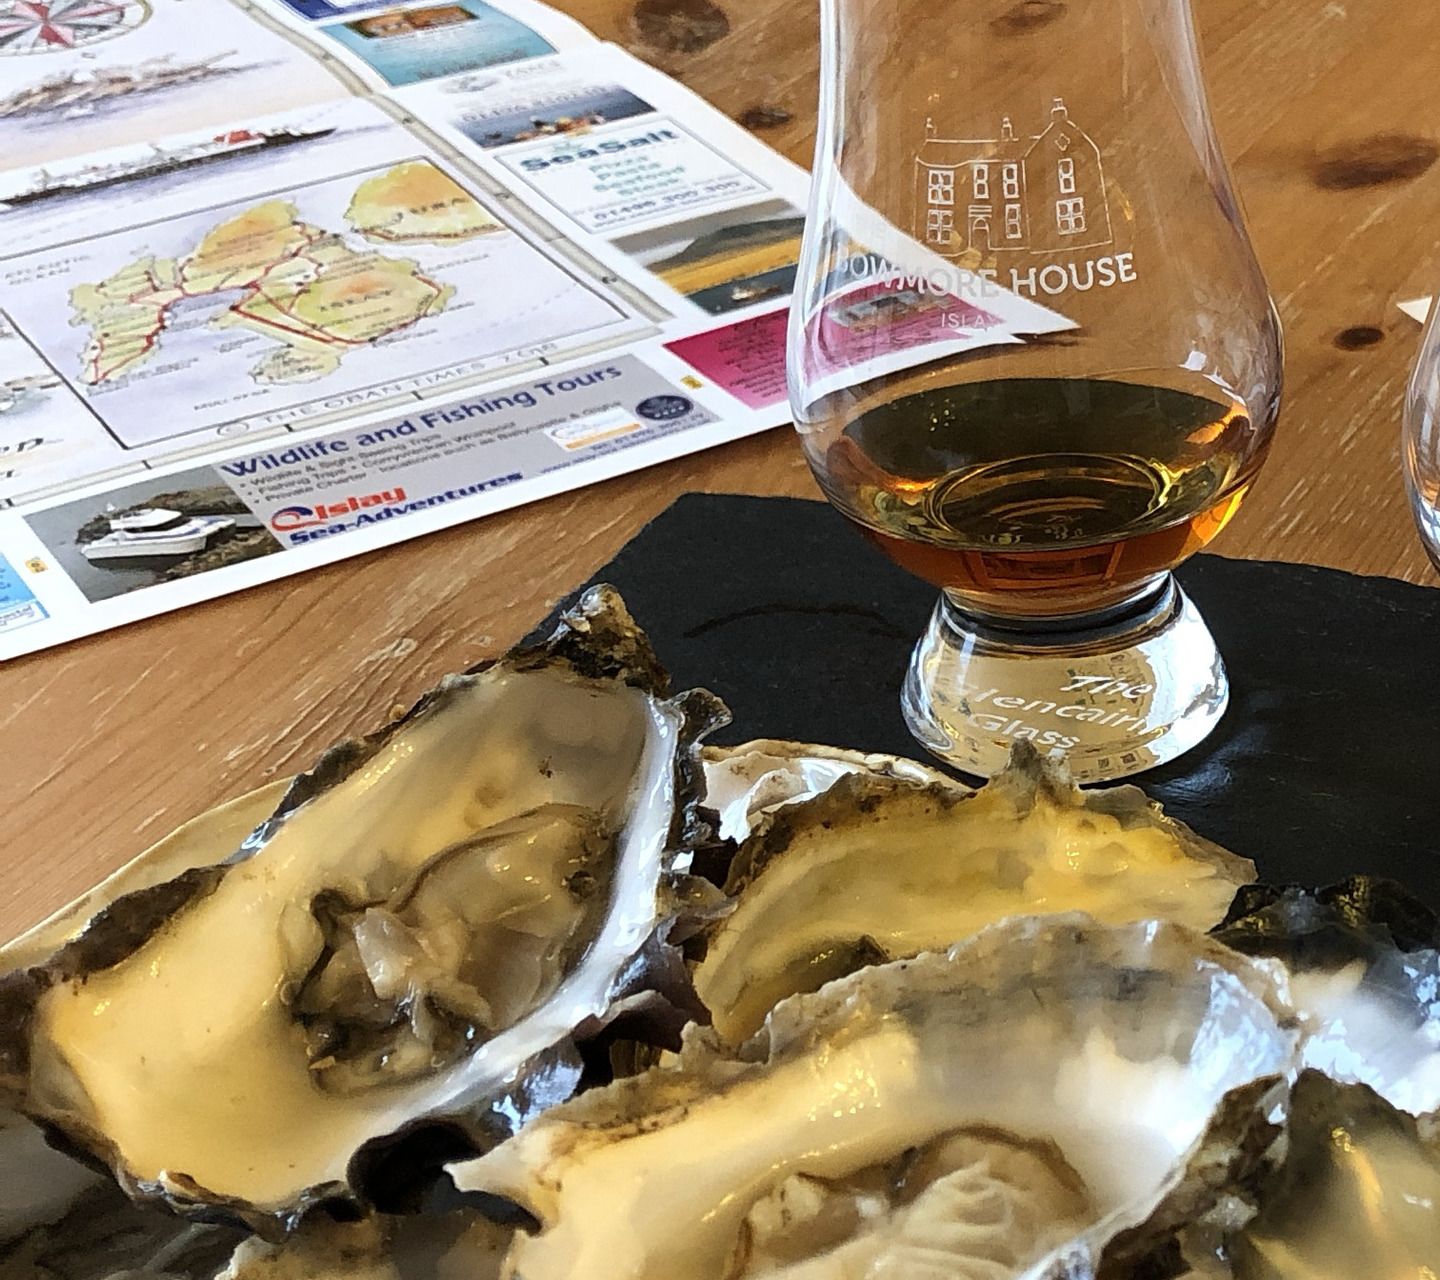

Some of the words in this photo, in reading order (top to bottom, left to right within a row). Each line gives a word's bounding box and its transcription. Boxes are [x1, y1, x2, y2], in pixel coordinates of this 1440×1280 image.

[1010, 252, 1138, 297] HOUSE
[221, 438, 350, 478] Wildlife
[355, 420, 418, 447] and
[420, 390, 538, 429] Fishing
[533, 365, 623, 397] Tours
[289, 472, 524, 545] Sea-Adventures
[315, 485, 407, 520] Islay
[1059, 675, 1153, 699] The
[970, 713, 1082, 750] Glass
[974, 688, 1149, 736] lencairn
